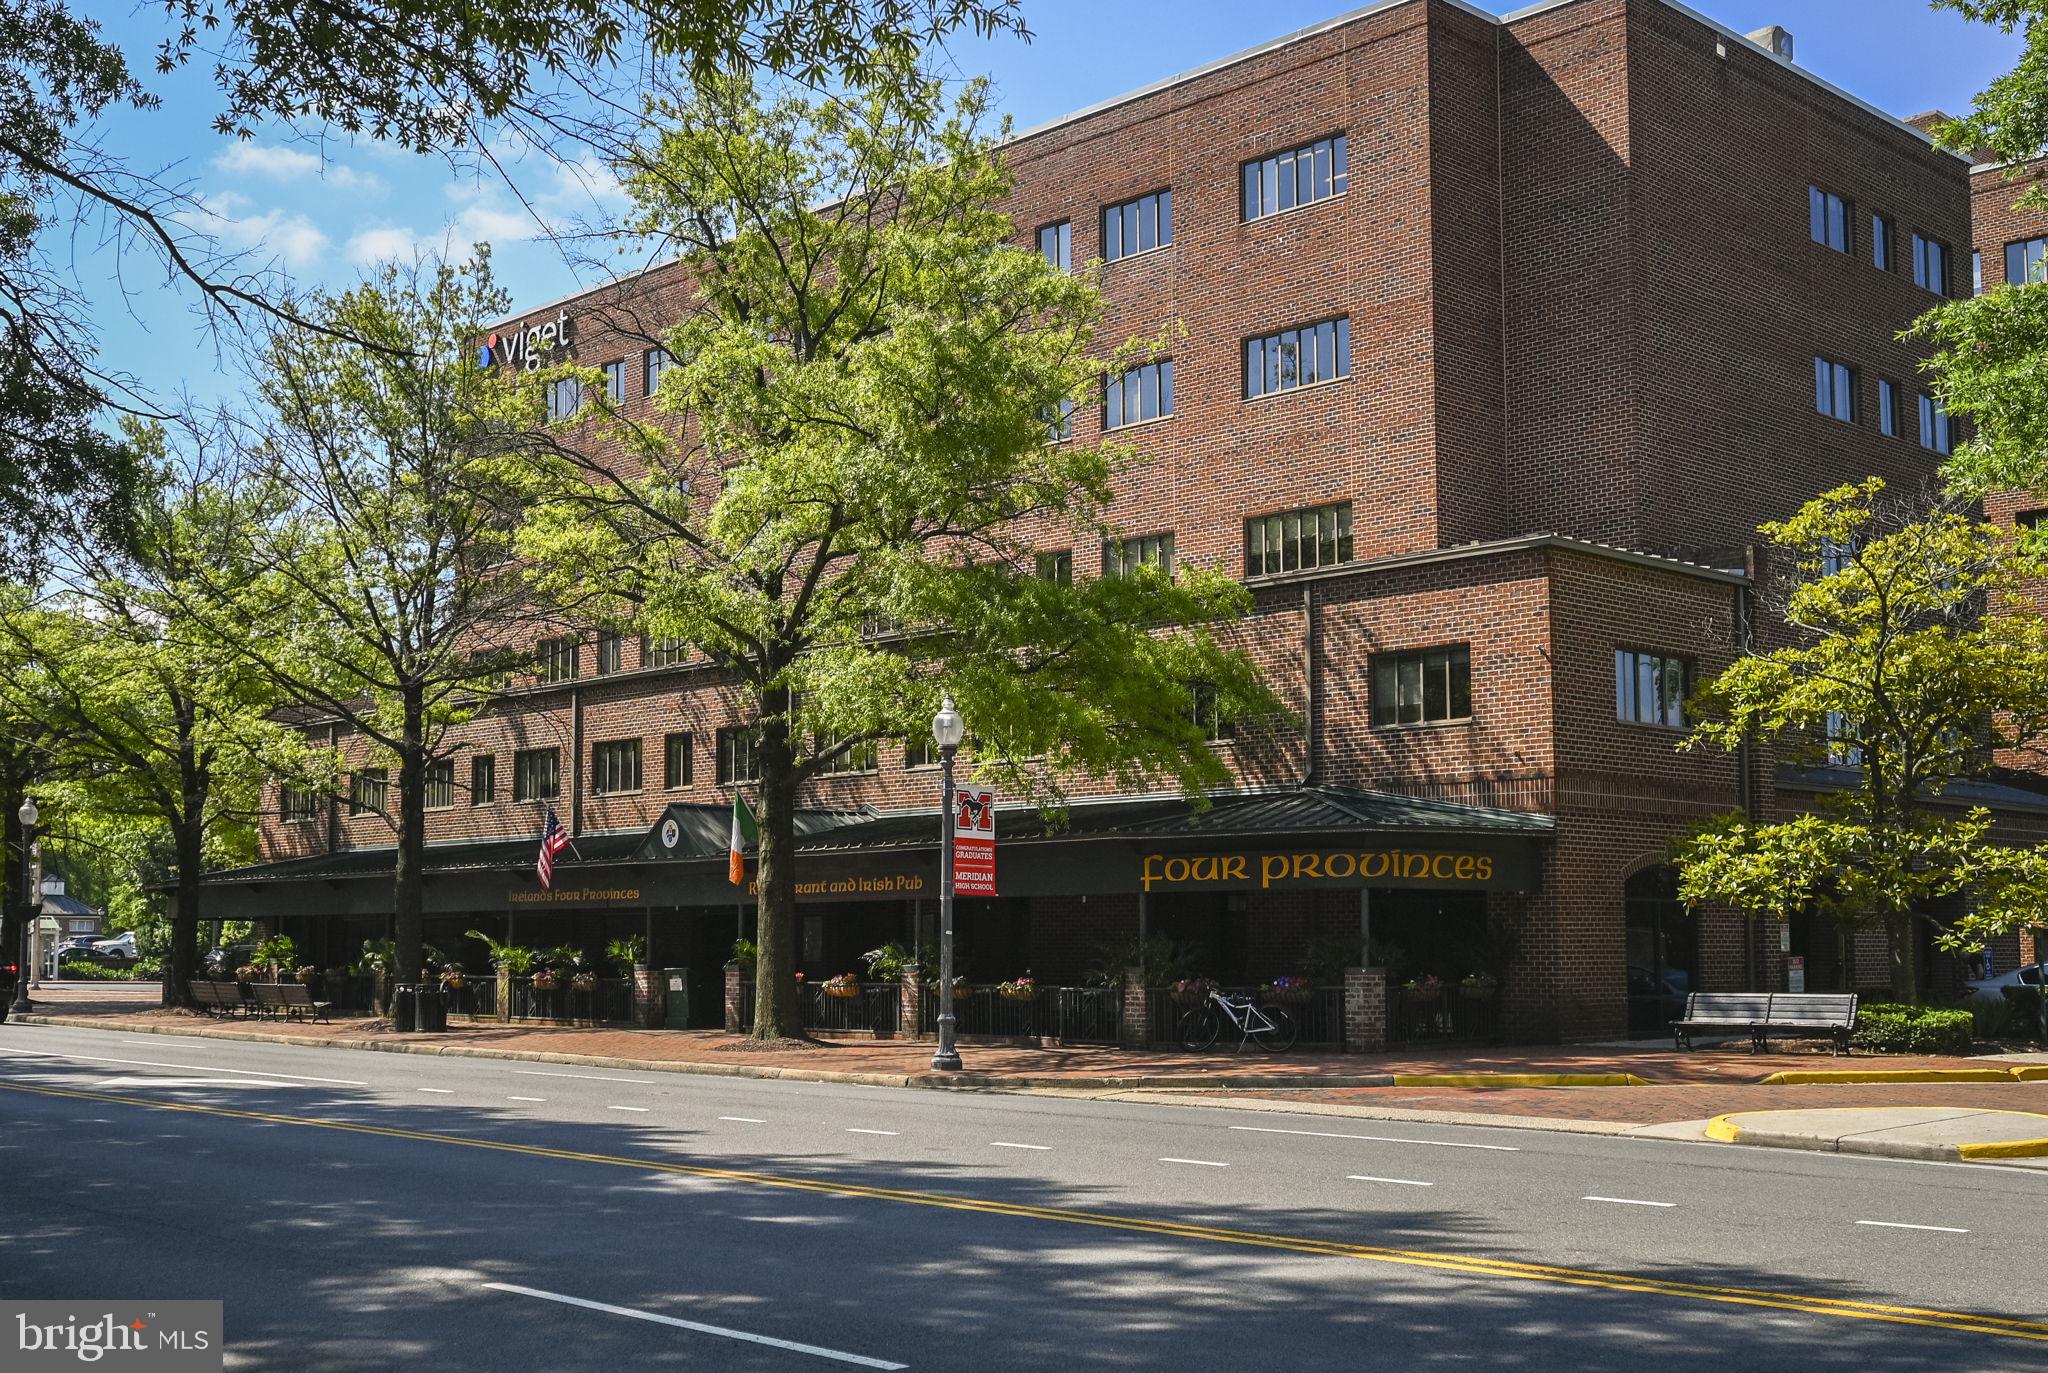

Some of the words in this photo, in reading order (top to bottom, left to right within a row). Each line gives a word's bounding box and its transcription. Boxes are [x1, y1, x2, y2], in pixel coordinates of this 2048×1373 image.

[502, 309, 569, 374] viget
[955, 851, 993, 860] GRADUATES
[955, 872, 993, 881] MERIDIAN
[748, 880, 827, 895] Rrant
[830, 878, 856, 892] and
[859, 876, 893, 892] Irish
[896, 875, 923, 890] Pub
[955, 882, 970, 890] HIGH
[970, 883, 994, 891] SCHOOL
[554, 889, 580, 901] Four
[582, 888, 640, 900] Provinces
